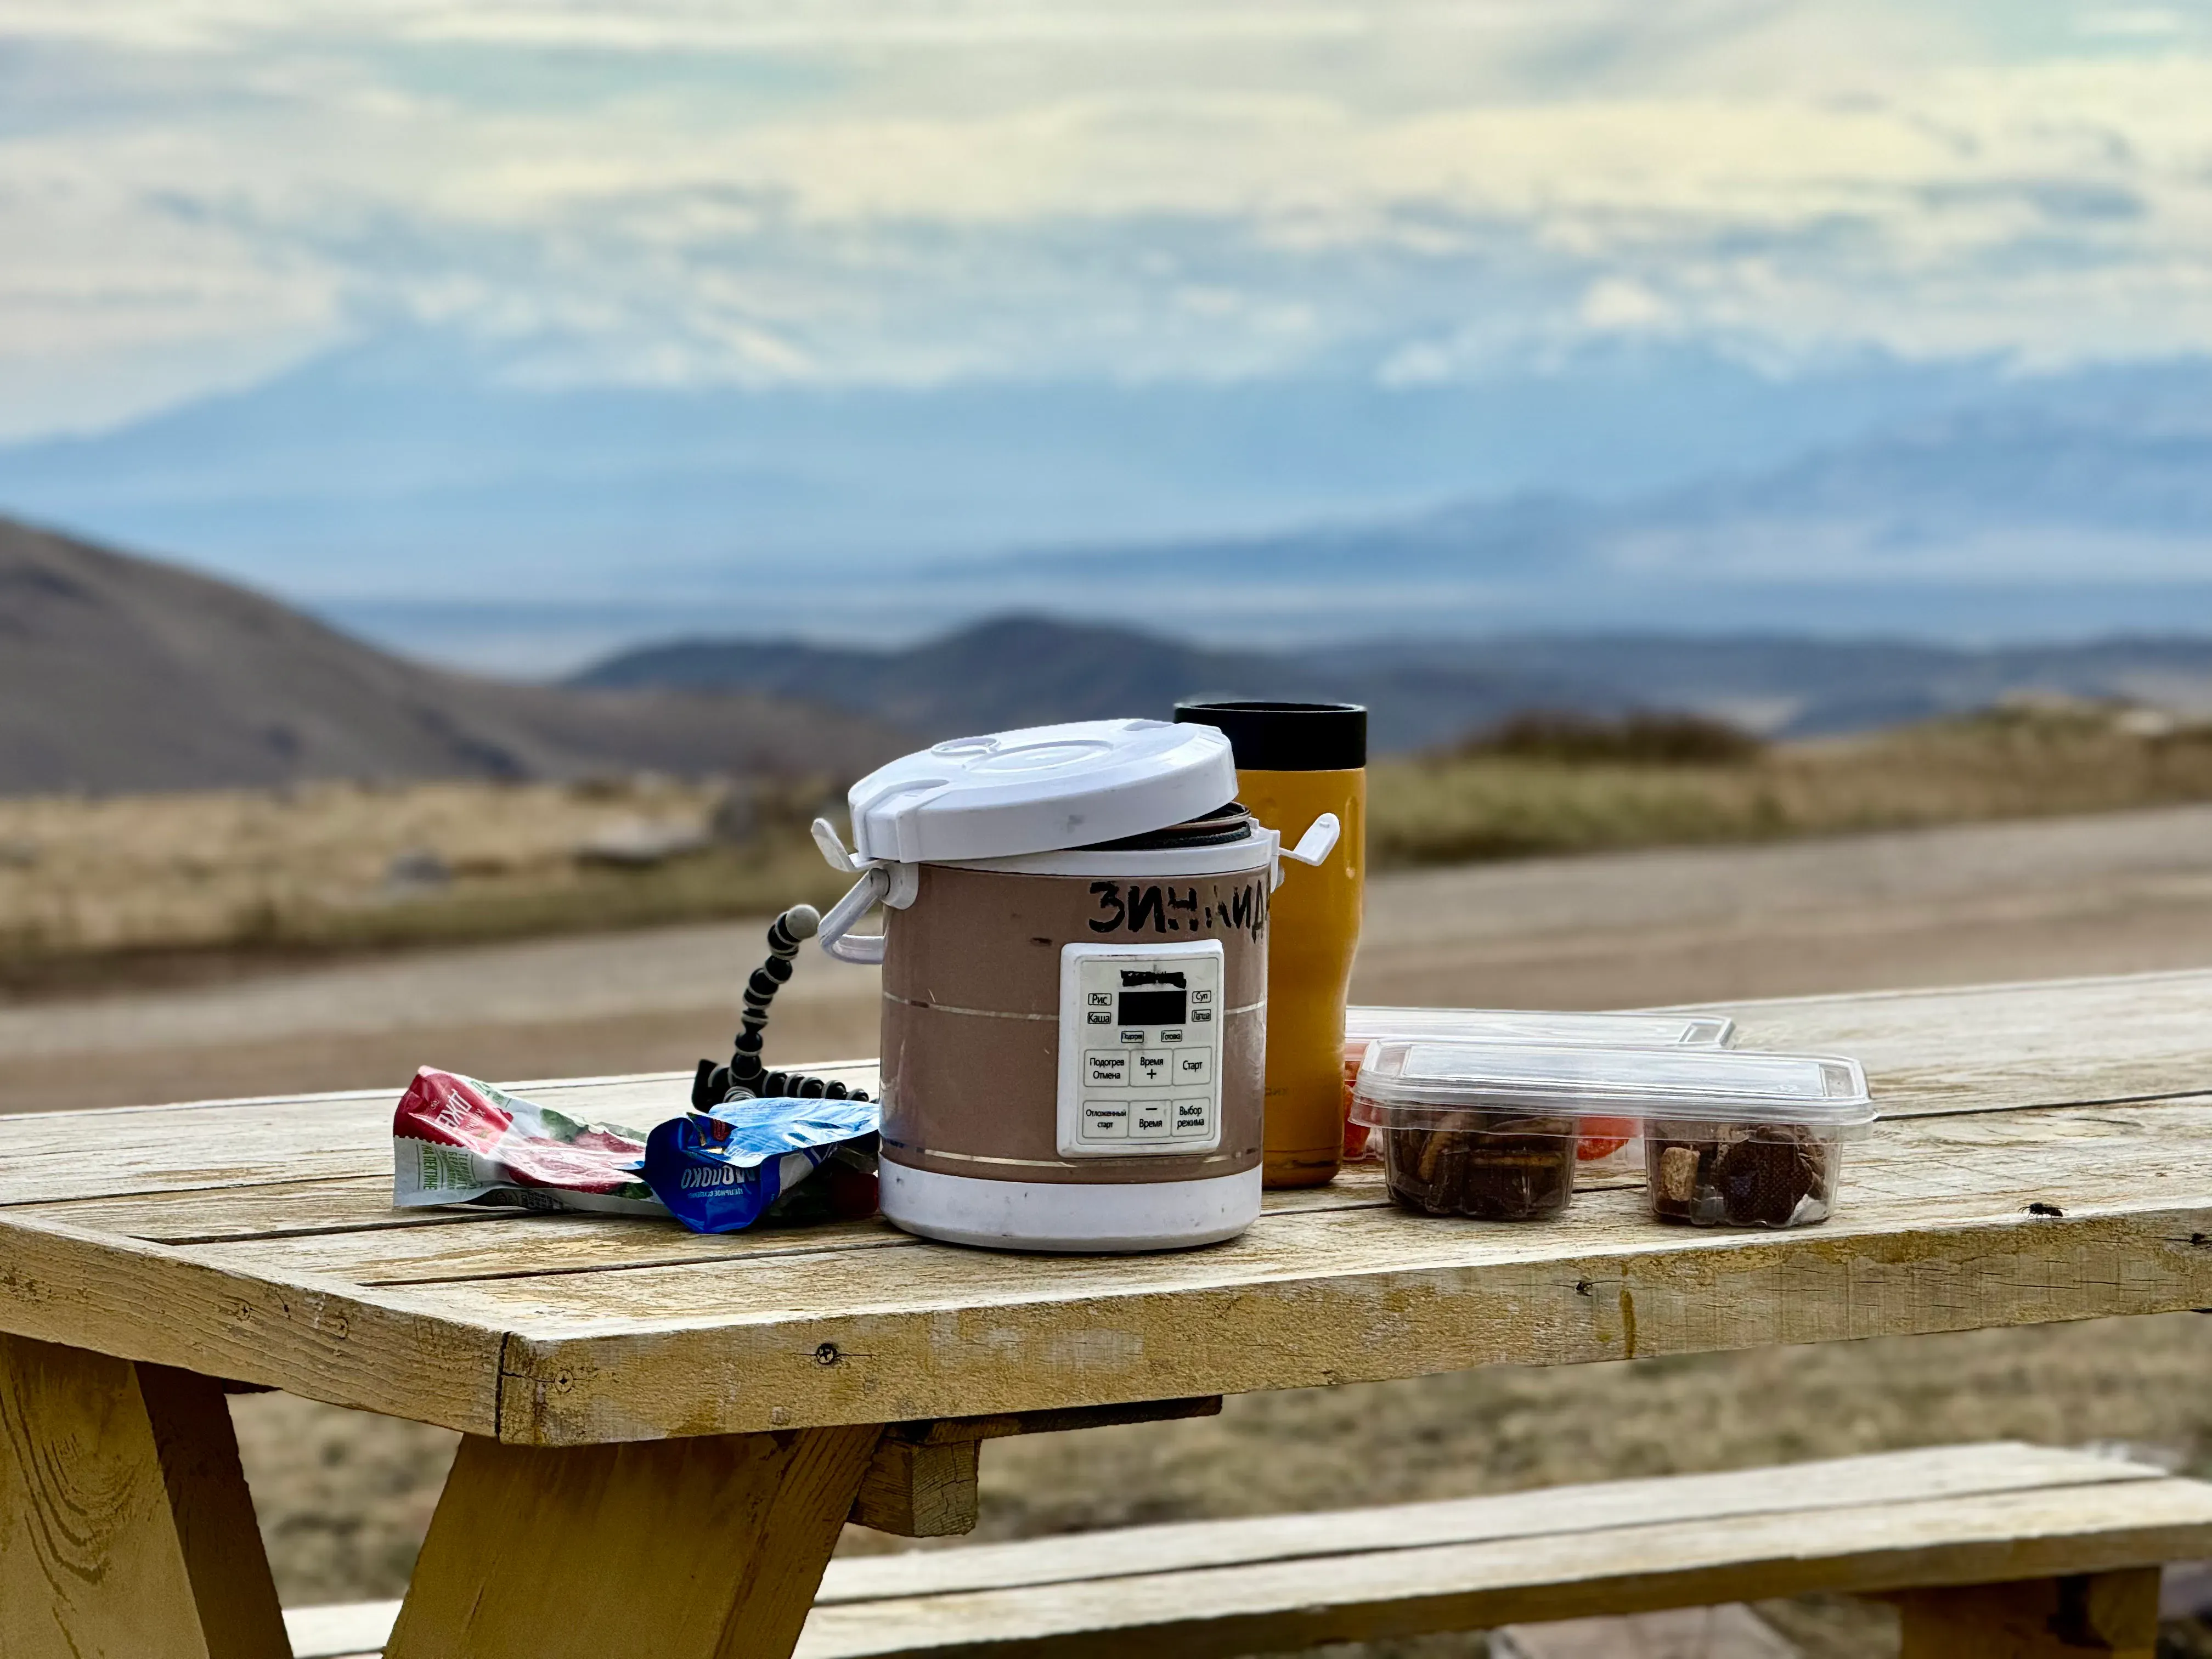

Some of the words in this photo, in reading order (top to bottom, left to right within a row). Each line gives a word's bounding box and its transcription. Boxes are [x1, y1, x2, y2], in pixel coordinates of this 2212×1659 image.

[1092, 994, 1108, 1005] Рис
[1195, 992, 1208, 1002] Суп
[1088, 1012, 1110, 1023] Каша
[1193, 1012, 1210, 1020] Лапша
[1090, 1058, 1125, 1068] Подогрев
[1140, 1057, 1164, 1068] Время
[1182, 1060, 1203, 1072] Старт
[1093, 1070, 1121, 1079] Отмена
[1179, 1105, 1203, 1116] Выбор
[1097, 1121, 1113, 1130] старт
[1139, 1119, 1163, 1130] Время
[1177, 1118, 1205, 1130] режима
[421, 1144, 435, 1155] НА
[423, 1156, 438, 1190] ПЕКТИНЕ
[680, 1165, 756, 1189] МОЛОКО
[714, 1187, 743, 1197] ЦЕЛЬНОЕ
